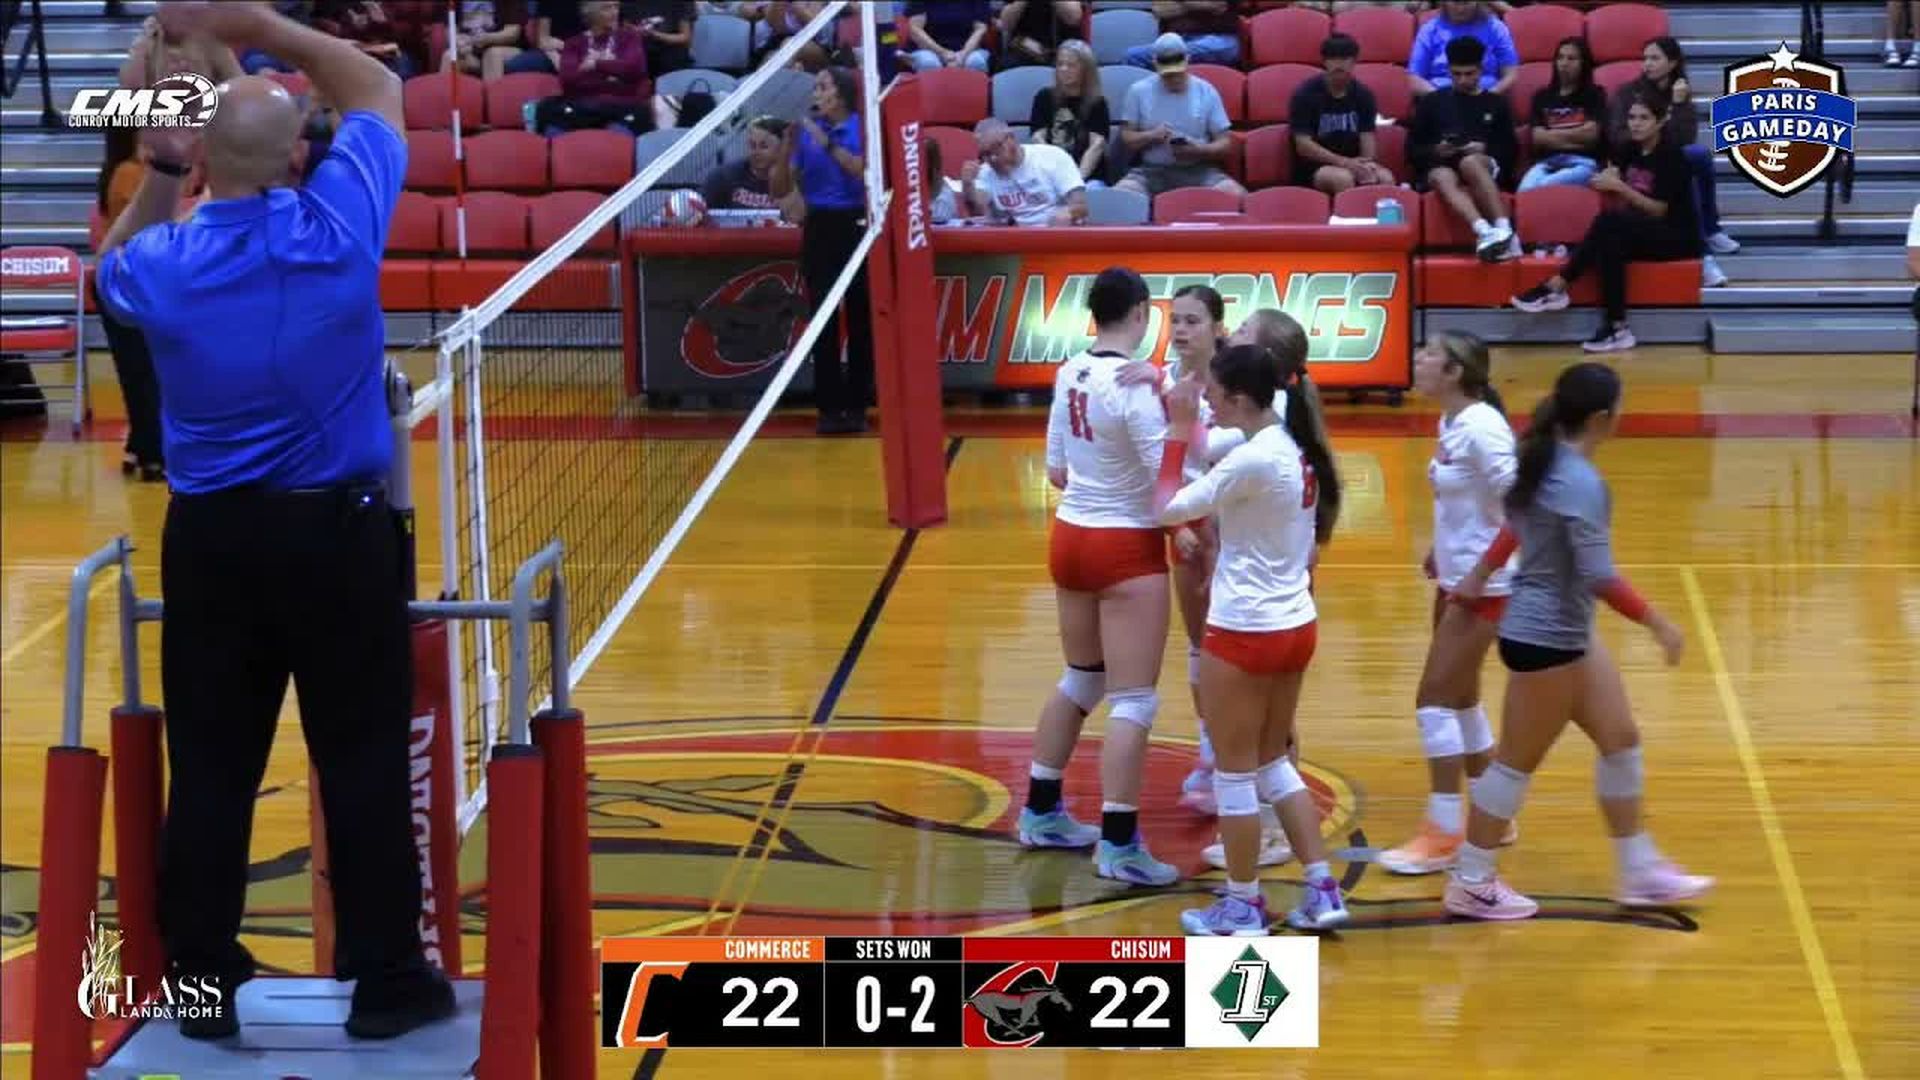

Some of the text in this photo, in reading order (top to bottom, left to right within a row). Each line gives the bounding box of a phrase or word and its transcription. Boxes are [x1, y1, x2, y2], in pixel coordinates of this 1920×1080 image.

[901, 121, 928, 250] SPALDING
[1, 257, 69, 275] CHISUM
[1067, 387, 1094, 442] 11
